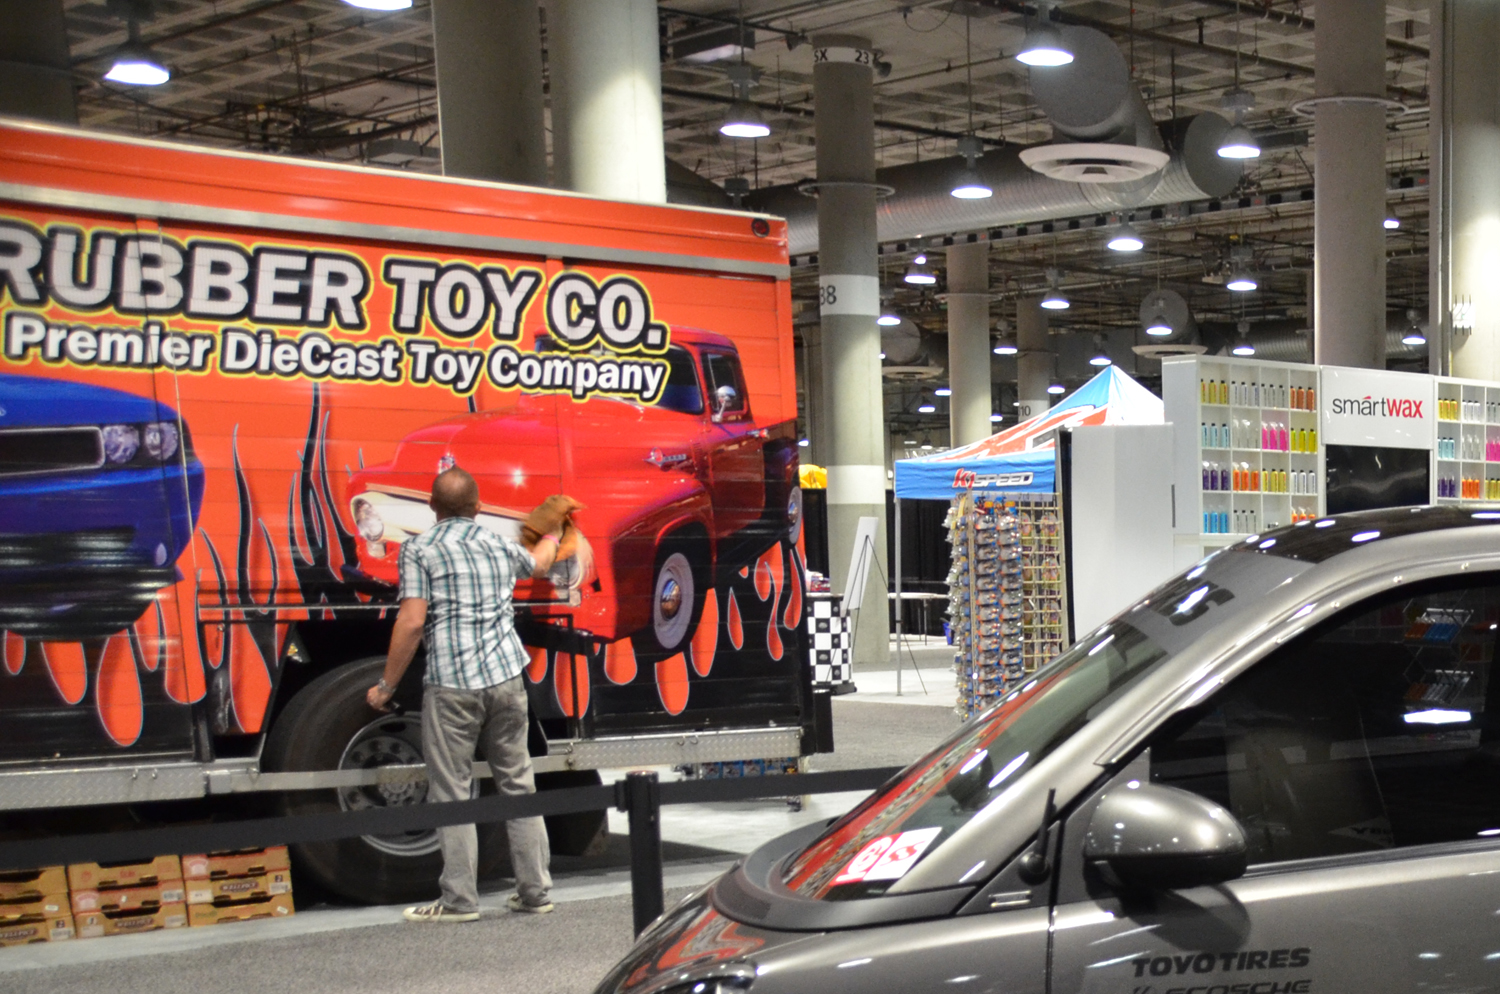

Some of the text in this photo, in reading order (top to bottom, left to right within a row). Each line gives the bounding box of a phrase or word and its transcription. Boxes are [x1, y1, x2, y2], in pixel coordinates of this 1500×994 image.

[0, 220, 669, 350] RUBBER TOY CO.
[5, 313, 666, 405] Premier DieCast Toy Company
[1219, 947, 1312, 972] TIRES
